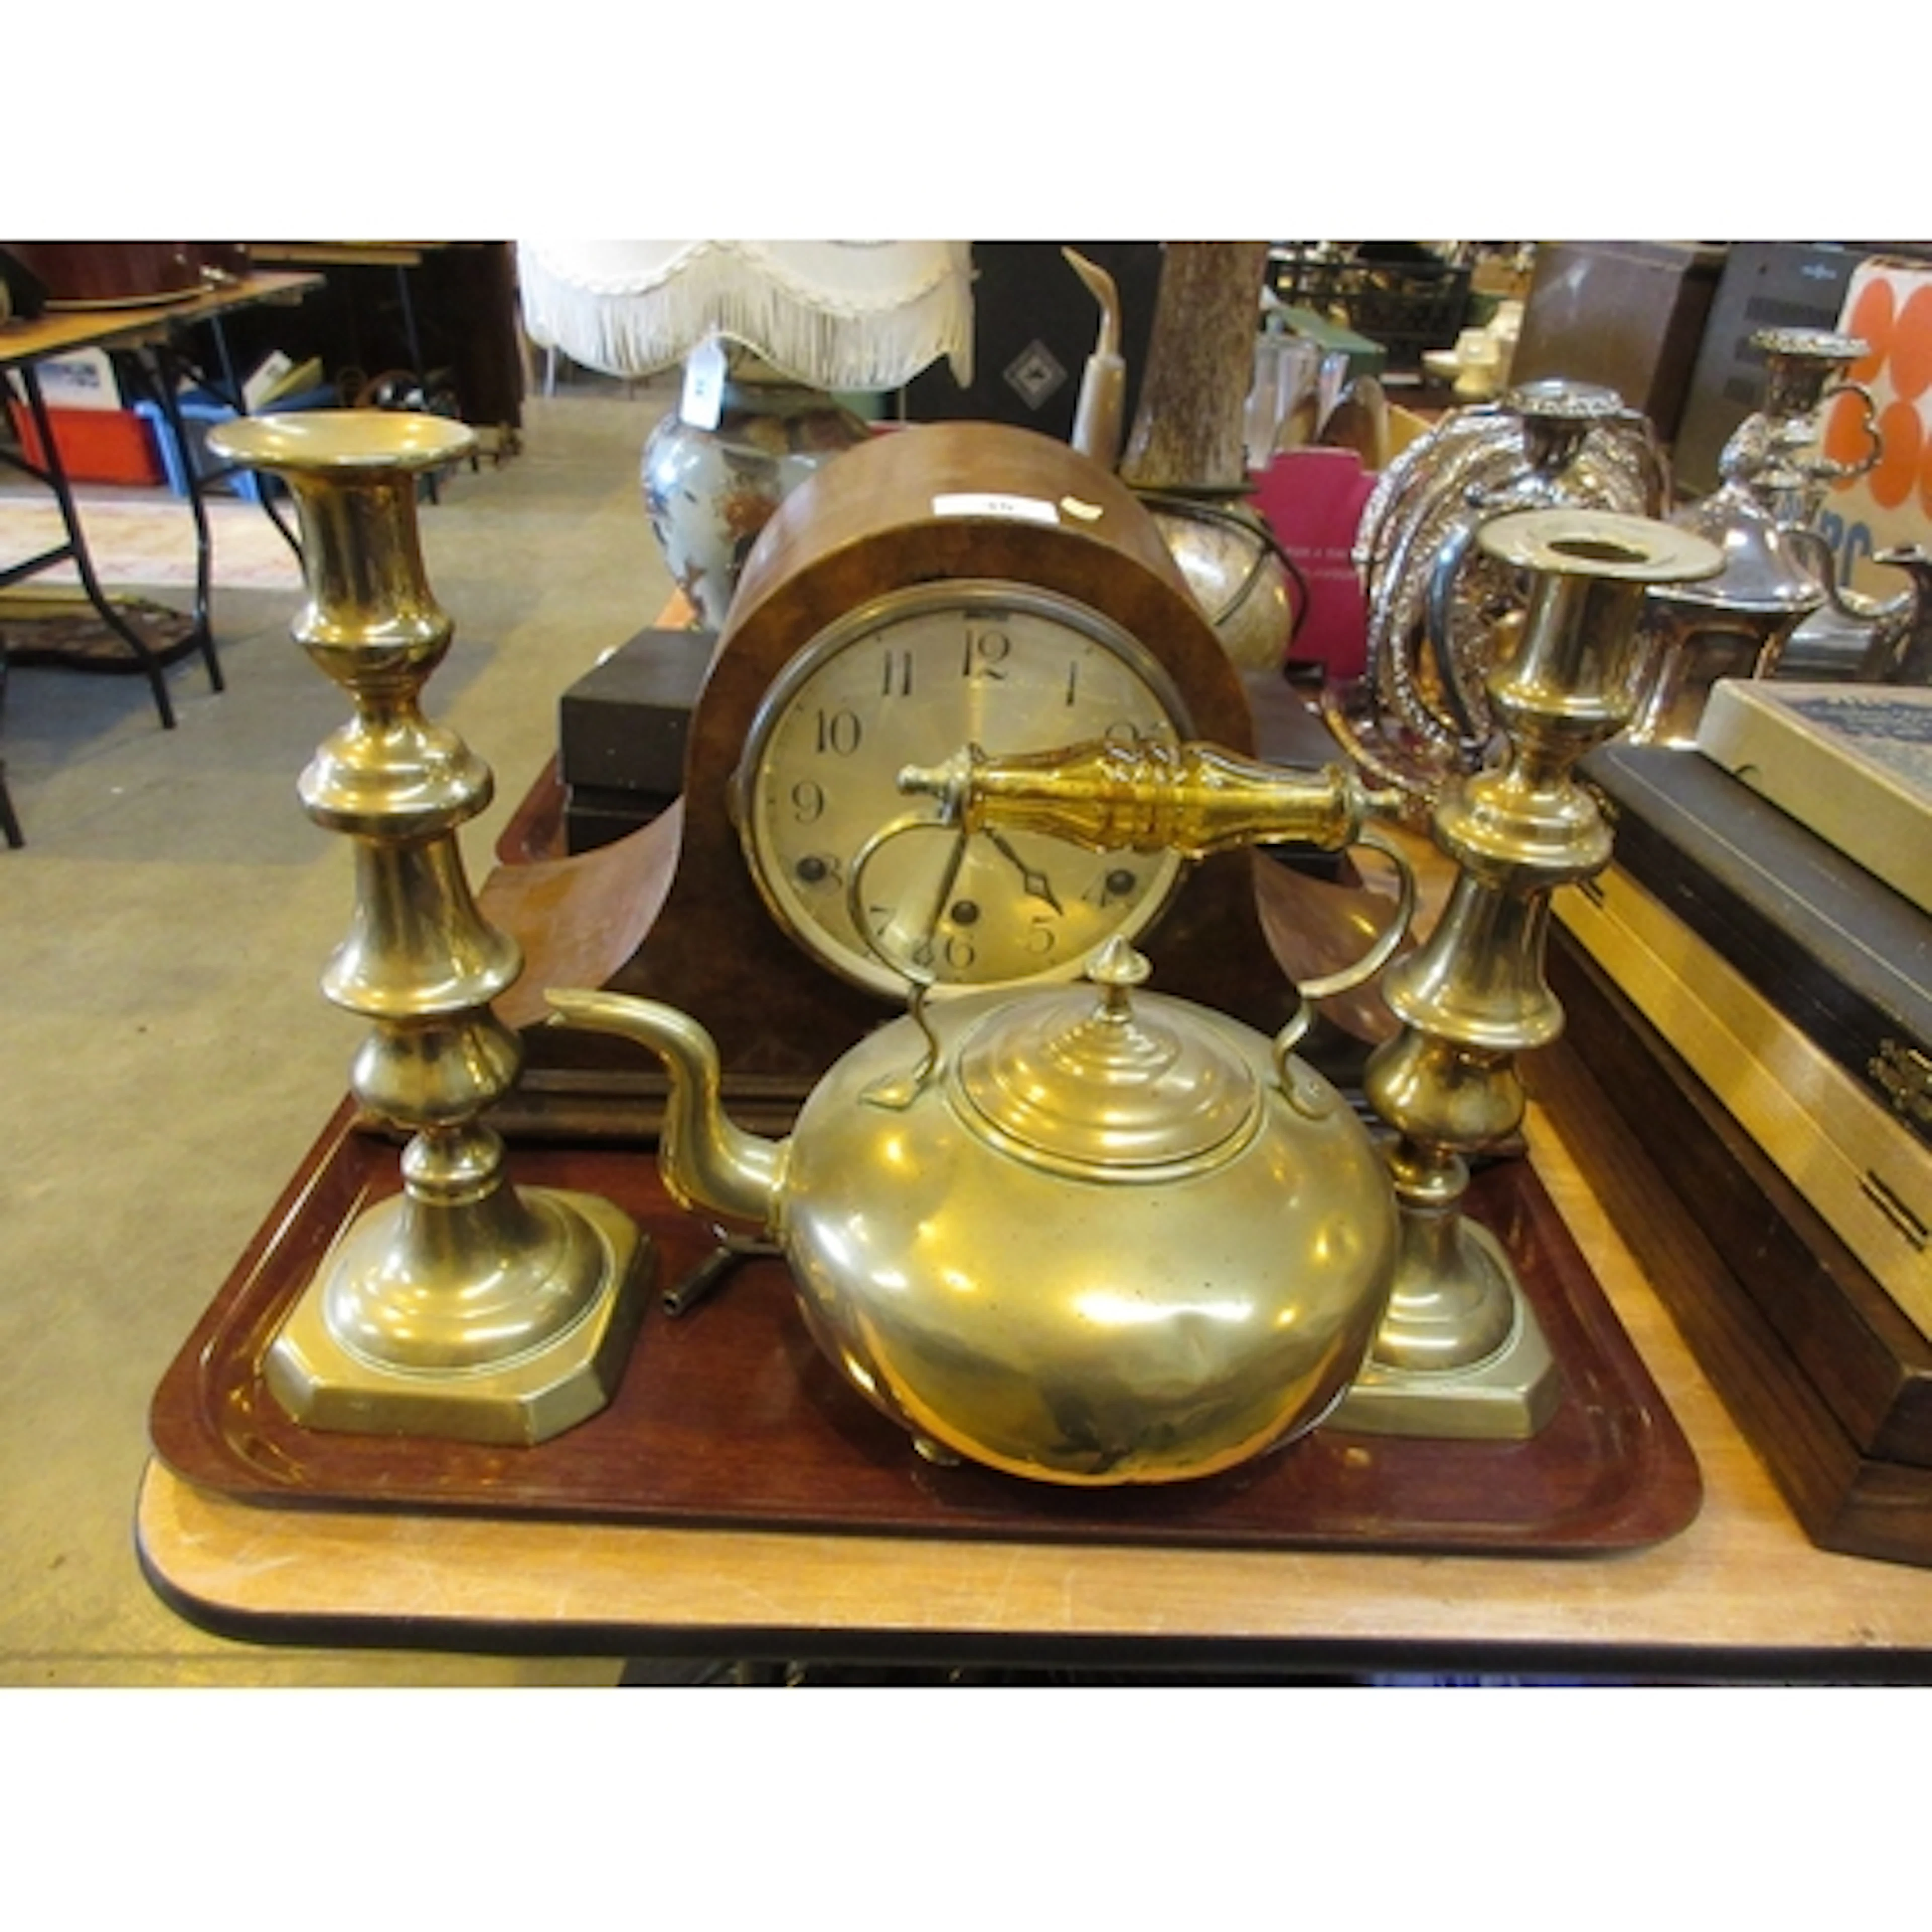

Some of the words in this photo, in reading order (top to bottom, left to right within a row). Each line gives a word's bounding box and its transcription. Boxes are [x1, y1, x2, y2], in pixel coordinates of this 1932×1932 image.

[881, 651, 913, 696] 11
[962, 629, 1011, 680] 12
[1066, 660, 1078, 706] 1
[815, 707, 862, 757] 10
[790, 779, 824, 825] 9
[944, 930, 976, 970] 6
[1024, 915, 1055, 954] 5
